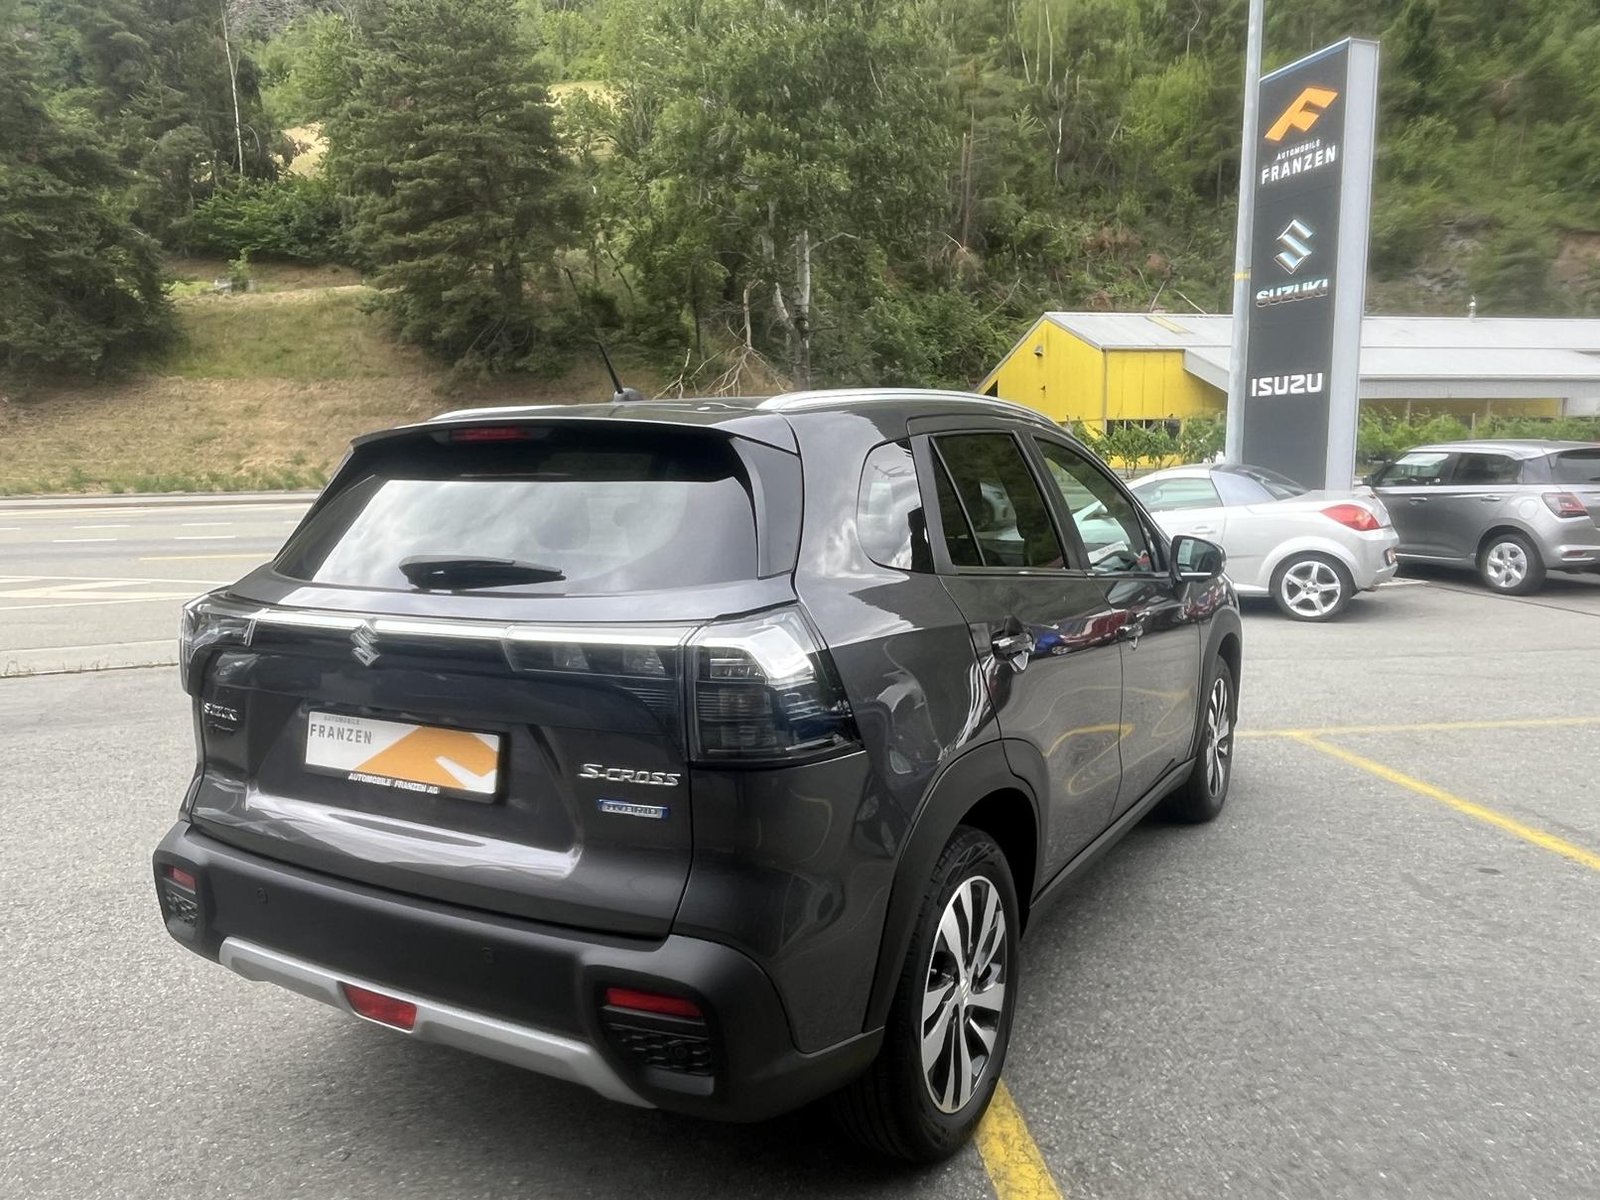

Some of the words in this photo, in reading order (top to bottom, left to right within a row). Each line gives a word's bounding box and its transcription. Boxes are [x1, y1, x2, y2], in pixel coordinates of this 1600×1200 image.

[1276, 139, 1321, 161] AUTOMOBILE
[1261, 145, 1337, 185] FRANZEN
[1256, 279, 1329, 308] SUZUKI
[1251, 372, 1324, 397] ISUZU
[323, 715, 361, 726] AUTOMOBILE
[310, 723, 373, 745] FRANZEN
[348, 772, 392, 787] AUTOMOBILE
[394, 780, 427, 793] FRANZEN
[577, 763, 681, 787] S-CROSS
